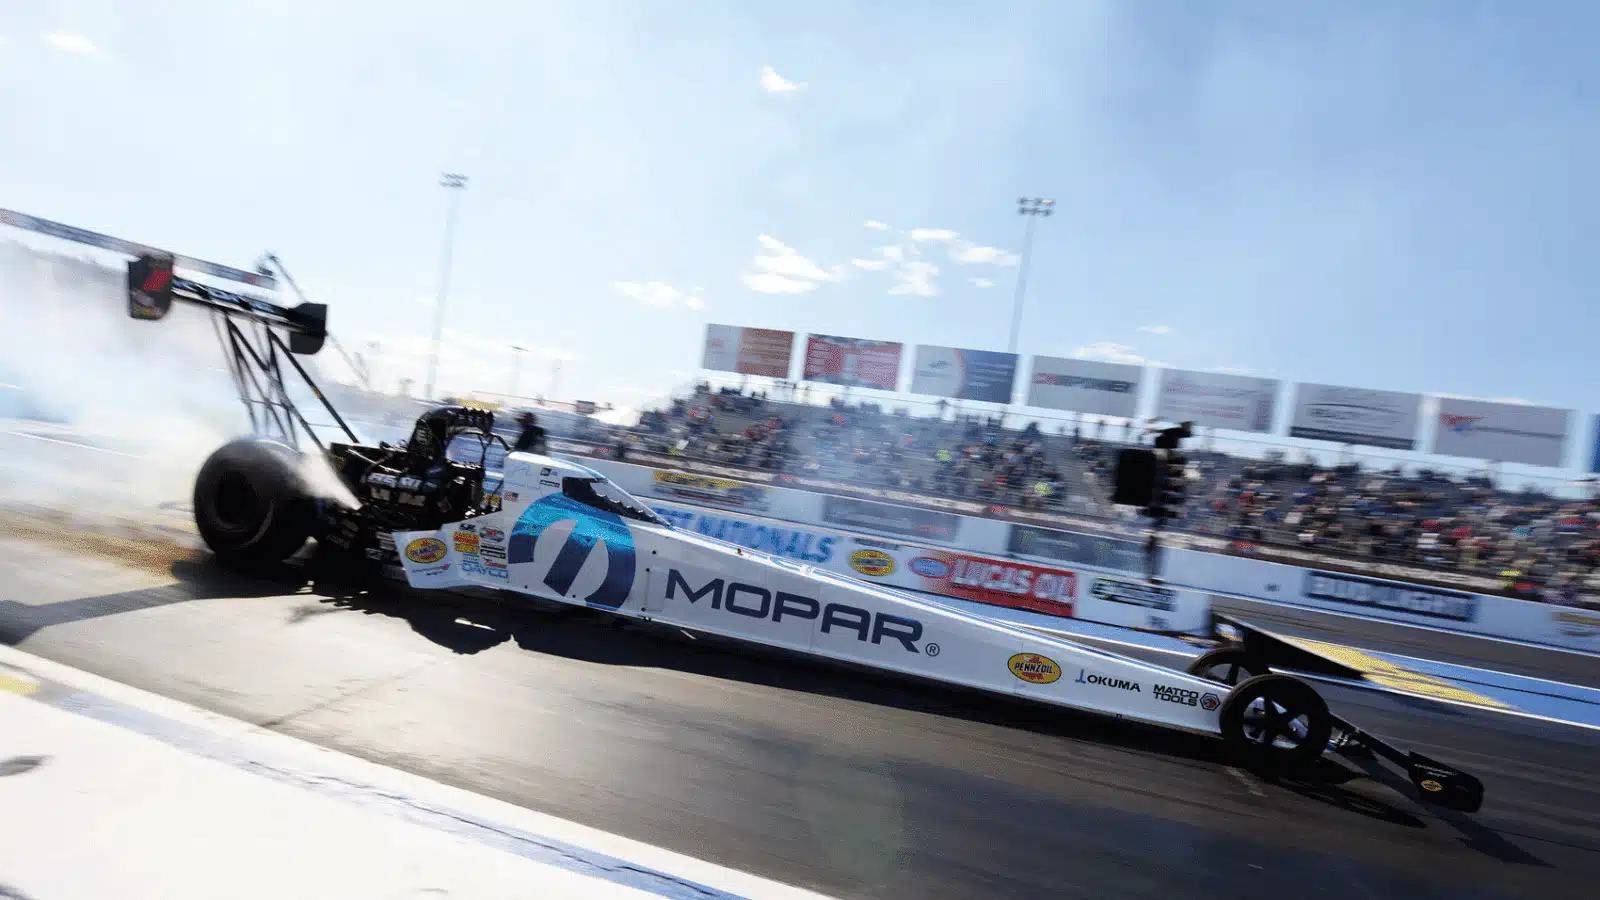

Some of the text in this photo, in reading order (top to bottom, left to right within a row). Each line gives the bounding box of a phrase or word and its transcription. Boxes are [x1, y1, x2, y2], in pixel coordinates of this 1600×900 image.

[953, 558, 1033, 594] LUCAS
[1034, 572, 1077, 603] OIL
[665, 568, 924, 654] MOPAR
[1014, 661, 1053, 674] PENNZOIL
[1087, 674, 1141, 693] OKUMA
[1153, 684, 1199, 699] MATCO
[1152, 691, 1198, 707] TOOLS
